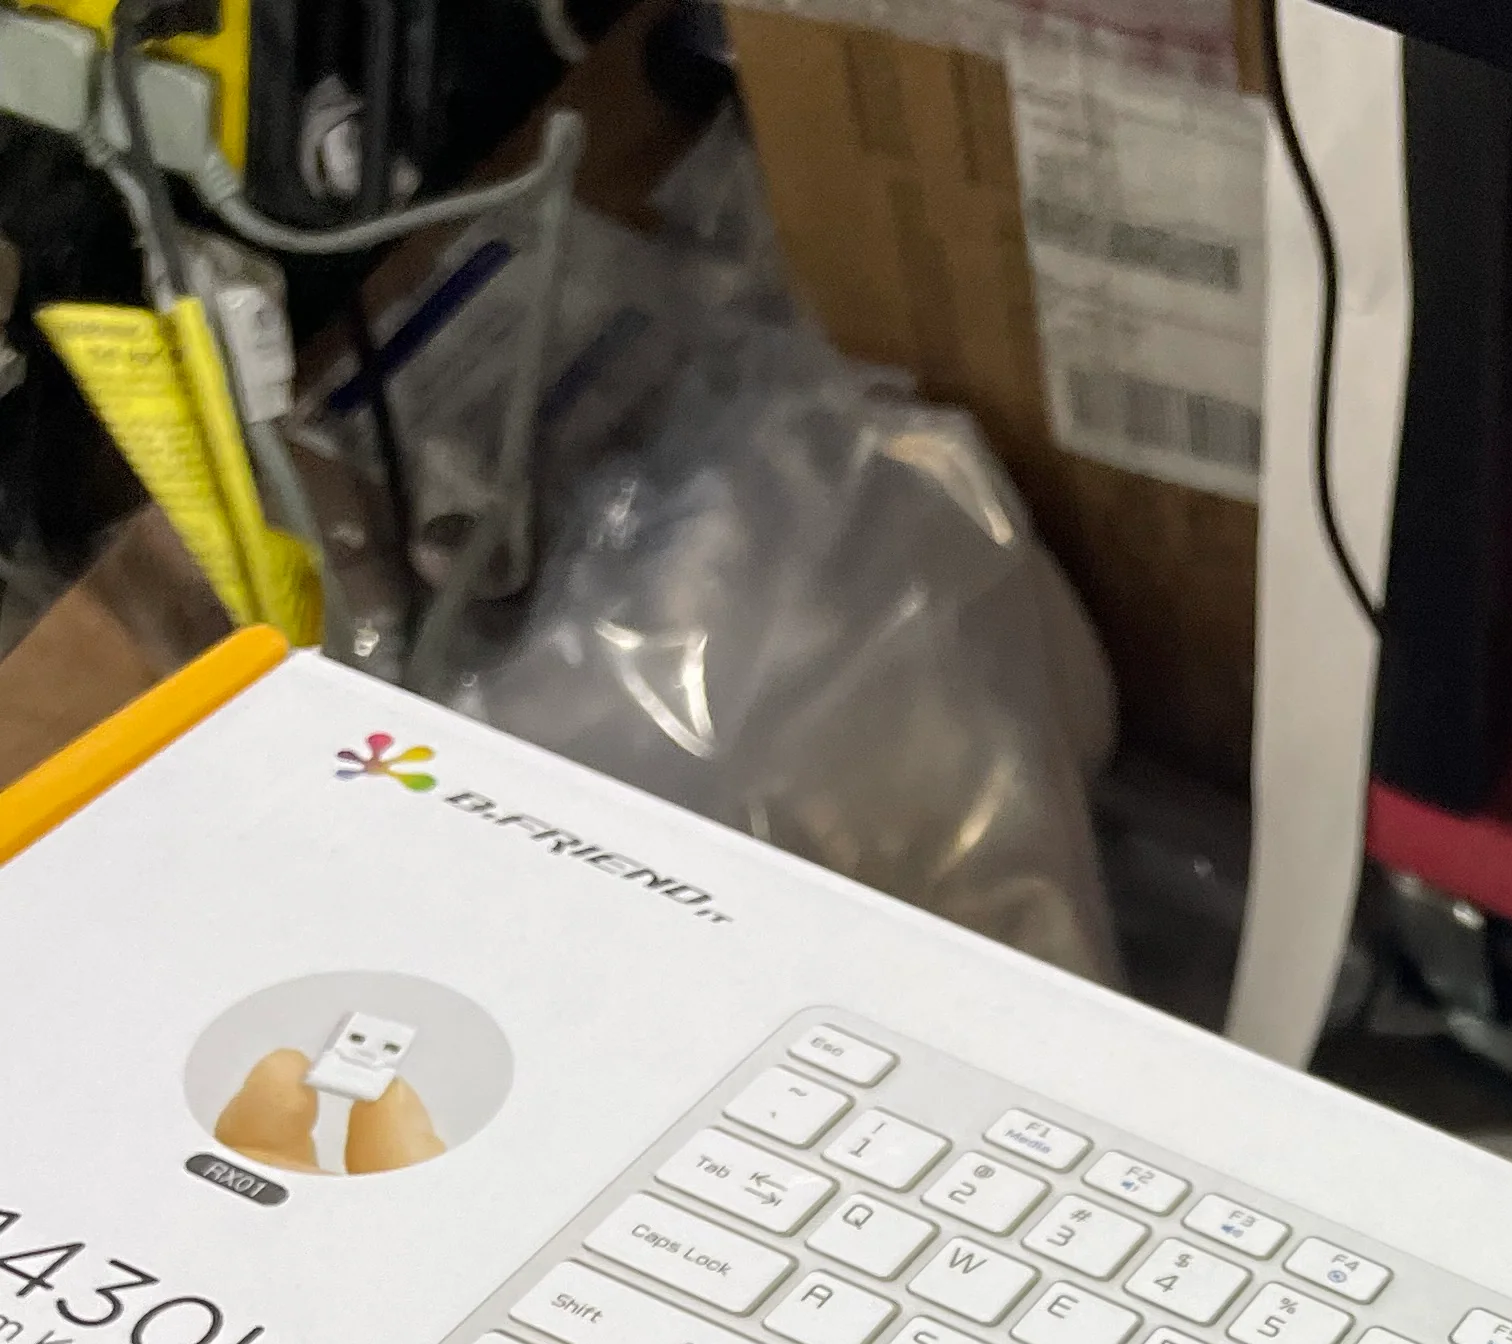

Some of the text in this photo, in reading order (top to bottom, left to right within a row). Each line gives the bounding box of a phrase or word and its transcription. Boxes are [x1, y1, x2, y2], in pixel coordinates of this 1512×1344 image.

[445, 791, 712, 906] B.FRIEND
[848, 1137, 872, 1158] 1
[201, 1161, 268, 1198] RX01
[696, 1154, 731, 1179] Tab
[947, 1181, 977, 1205] 2
[842, 1203, 875, 1230] Q
[1046, 1224, 1077, 1247] 3
[630, 1223, 733, 1277] Caps Lock
[948, 1247, 988, 1275] W
[1331, 1253, 1360, 1272] F4
[800, 1283, 834, 1309] A
[1153, 1274, 1180, 1293] 4
[551, 1293, 603, 1324] Shift
[1046, 1293, 1079, 1319] E
[1256, 1315, 1287, 1338] 5
